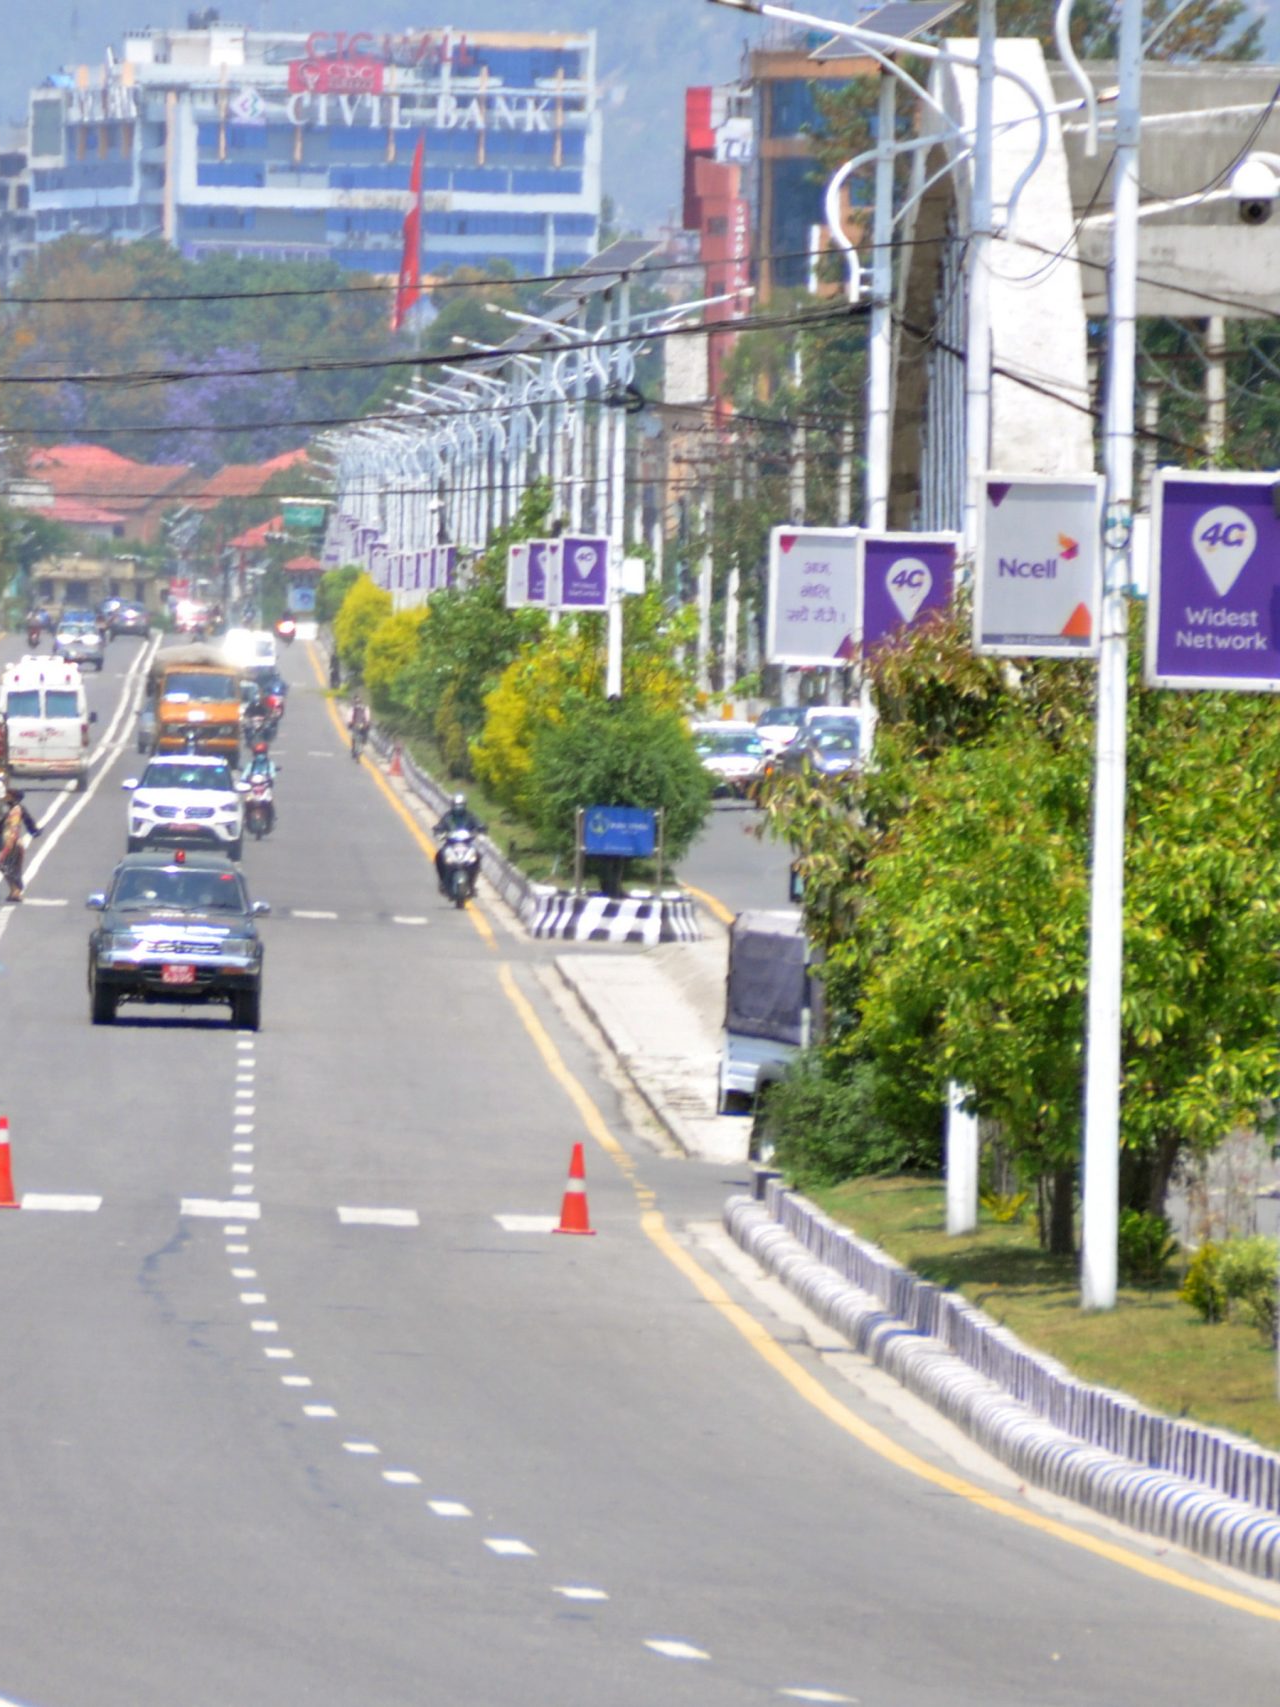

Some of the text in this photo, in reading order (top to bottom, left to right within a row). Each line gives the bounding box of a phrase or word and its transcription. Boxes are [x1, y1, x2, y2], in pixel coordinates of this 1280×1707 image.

[286, 92, 551, 132] CIVIL BANK
[998, 557, 1057, 579] Ncell
[1185, 606, 1259, 627] Widest
[1176, 630, 1269, 650] Network
